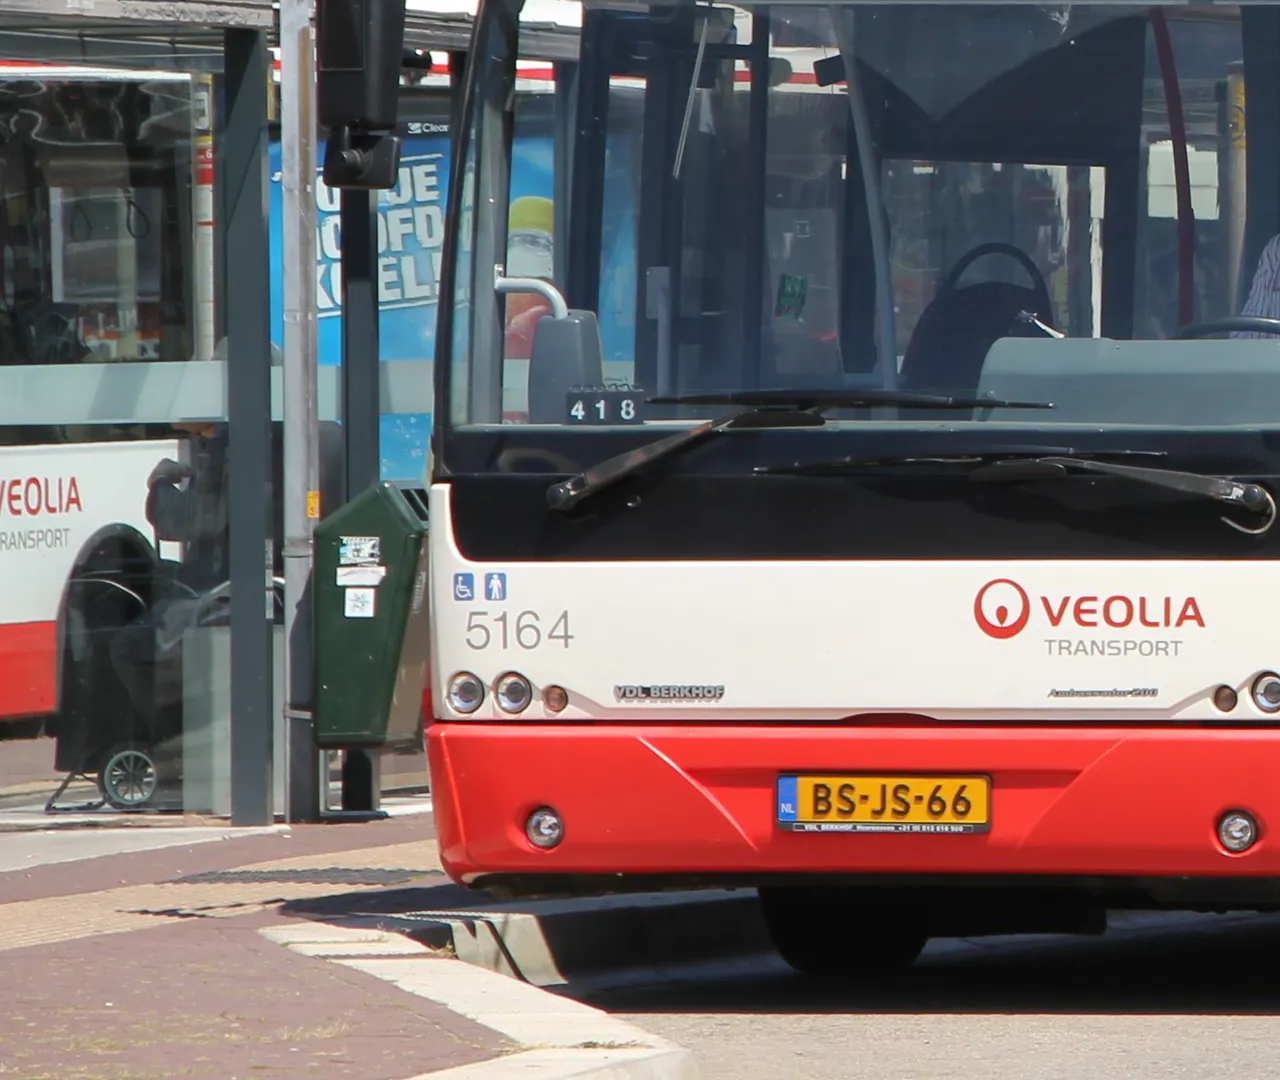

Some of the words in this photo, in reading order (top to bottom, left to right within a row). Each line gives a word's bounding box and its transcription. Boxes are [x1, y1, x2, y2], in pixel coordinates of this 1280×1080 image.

[0, 528, 70, 552] RANSPORT
[1040, 595, 1206, 628] VEOLIA
[465, 609, 575, 650] 5164
[1044, 638, 1184, 657] TRANSPORT
[613, 684, 646, 699] VDL
[649, 684, 725, 699] BERKHOF
[780, 803, 795, 814] NL
[812, 783, 972, 818] BS-JS-66
